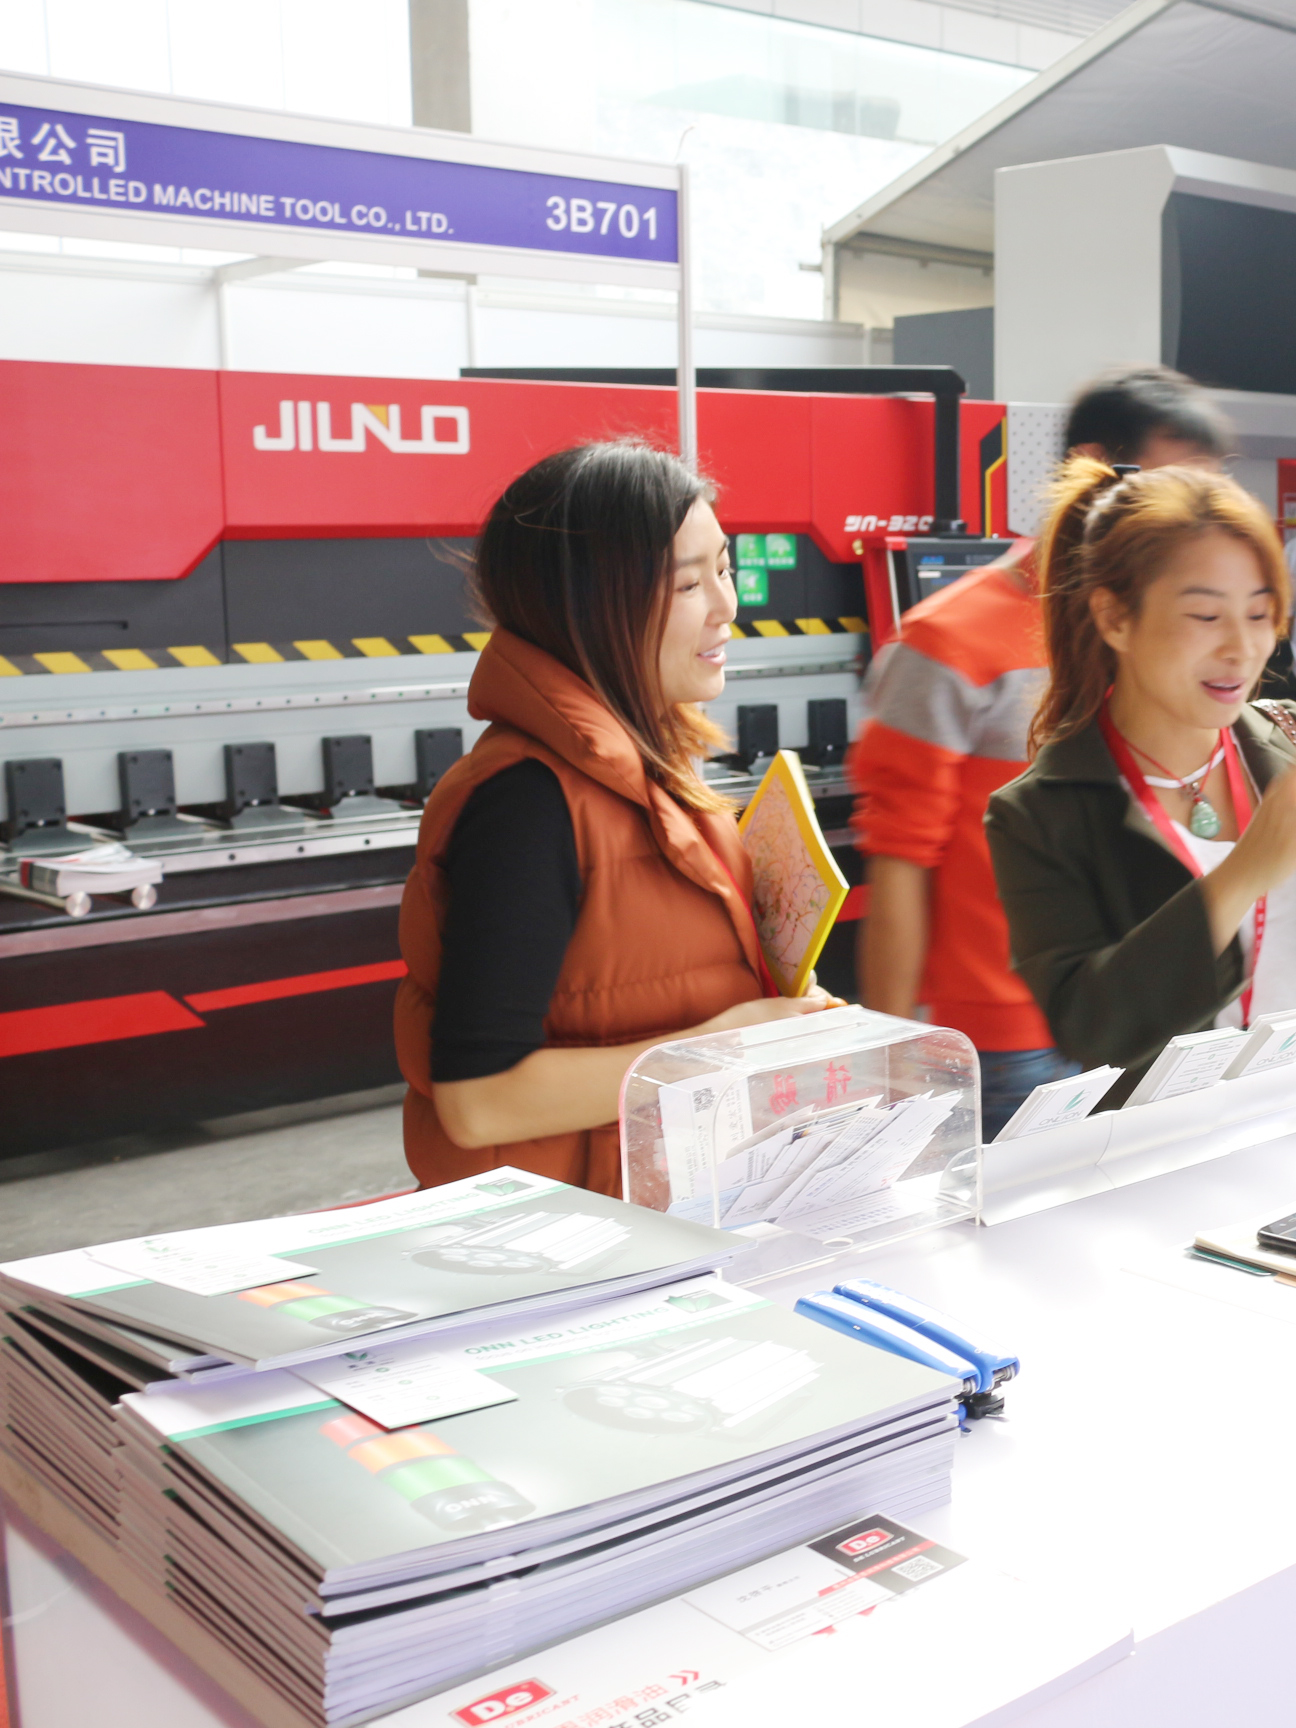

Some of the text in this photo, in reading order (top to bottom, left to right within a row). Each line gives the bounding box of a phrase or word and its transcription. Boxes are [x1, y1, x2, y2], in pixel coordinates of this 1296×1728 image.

[153, 183, 275, 217] MACHINE
[279, 196, 348, 224] TOOL
[350, 204, 401, 231] CO.,
[405, 210, 454, 234] LTD.
[546, 195, 657, 240] 3B701
[464, 1306, 670, 1355] ONN LED LIGHTING
